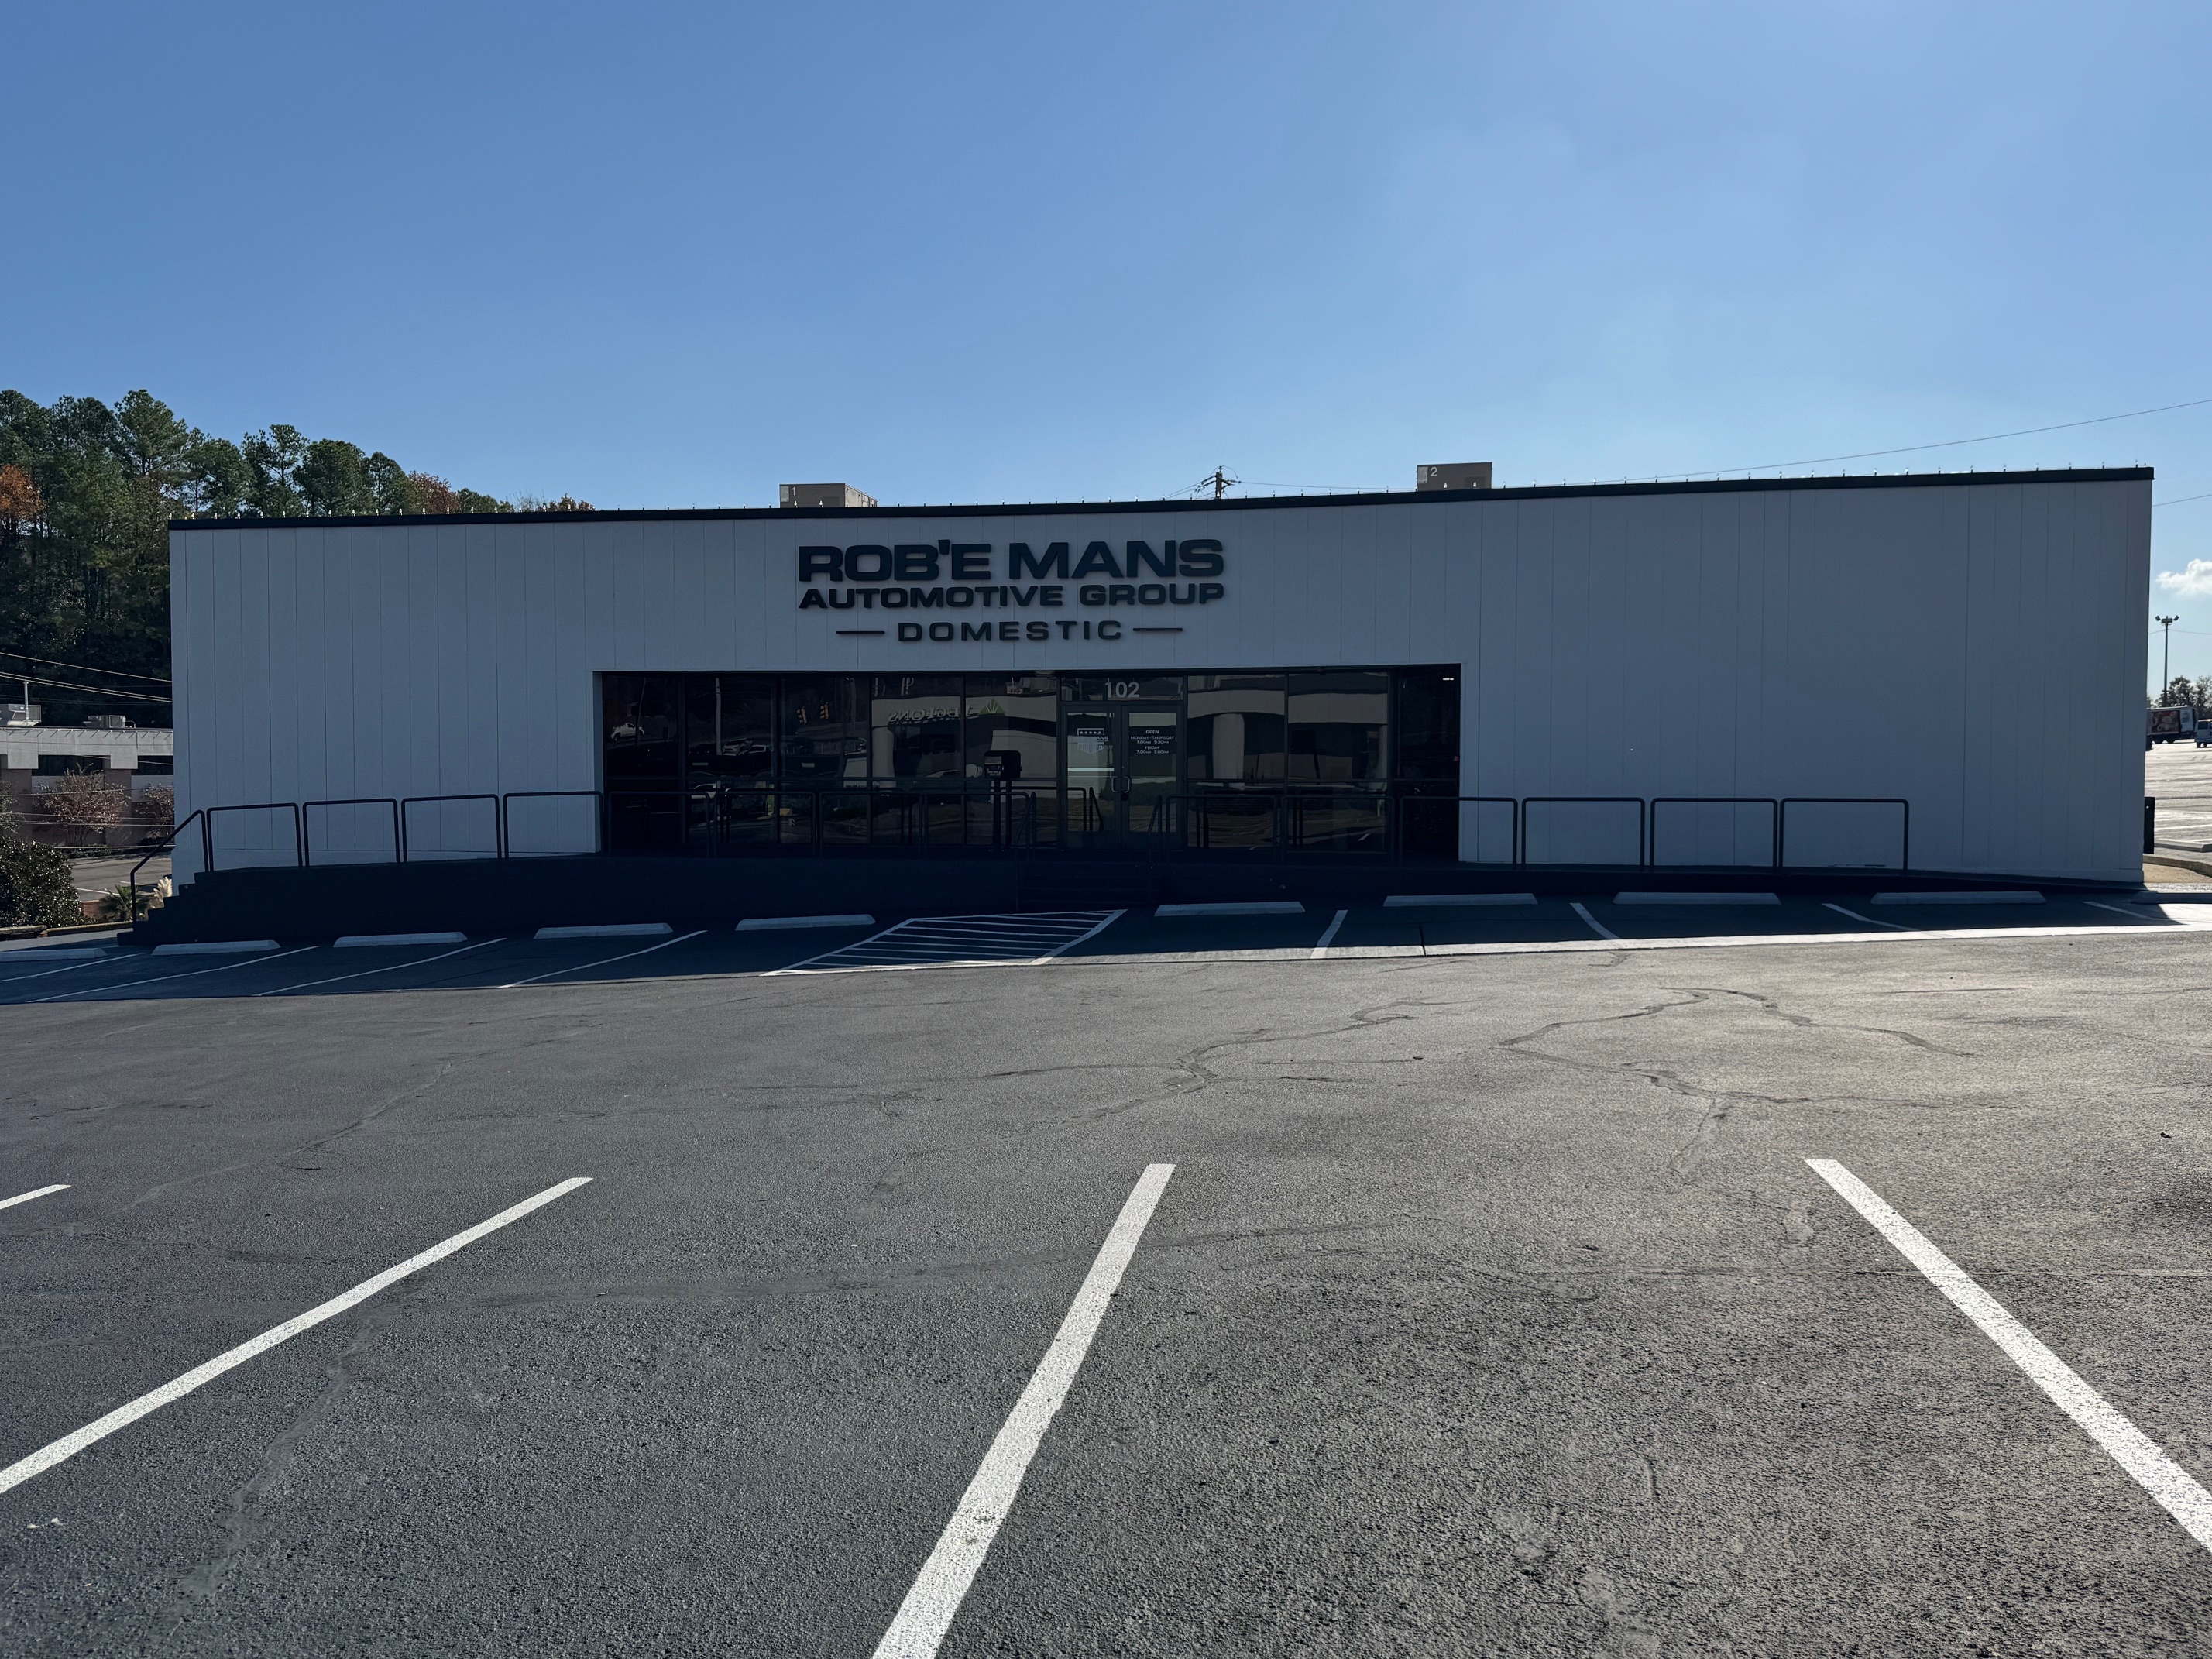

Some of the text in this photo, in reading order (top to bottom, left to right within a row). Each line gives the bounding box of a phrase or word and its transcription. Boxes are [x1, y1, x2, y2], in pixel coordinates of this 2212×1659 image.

[1430, 466, 1438, 477] 2
[791, 486, 796, 496] 1
[799, 538, 1224, 582] ROB'E MANS
[799, 582, 1224, 609] AUTOMOTIVE GROUP
[898, 620, 1121, 642] DOMESTIC
[1104, 681, 1139, 698] 102
